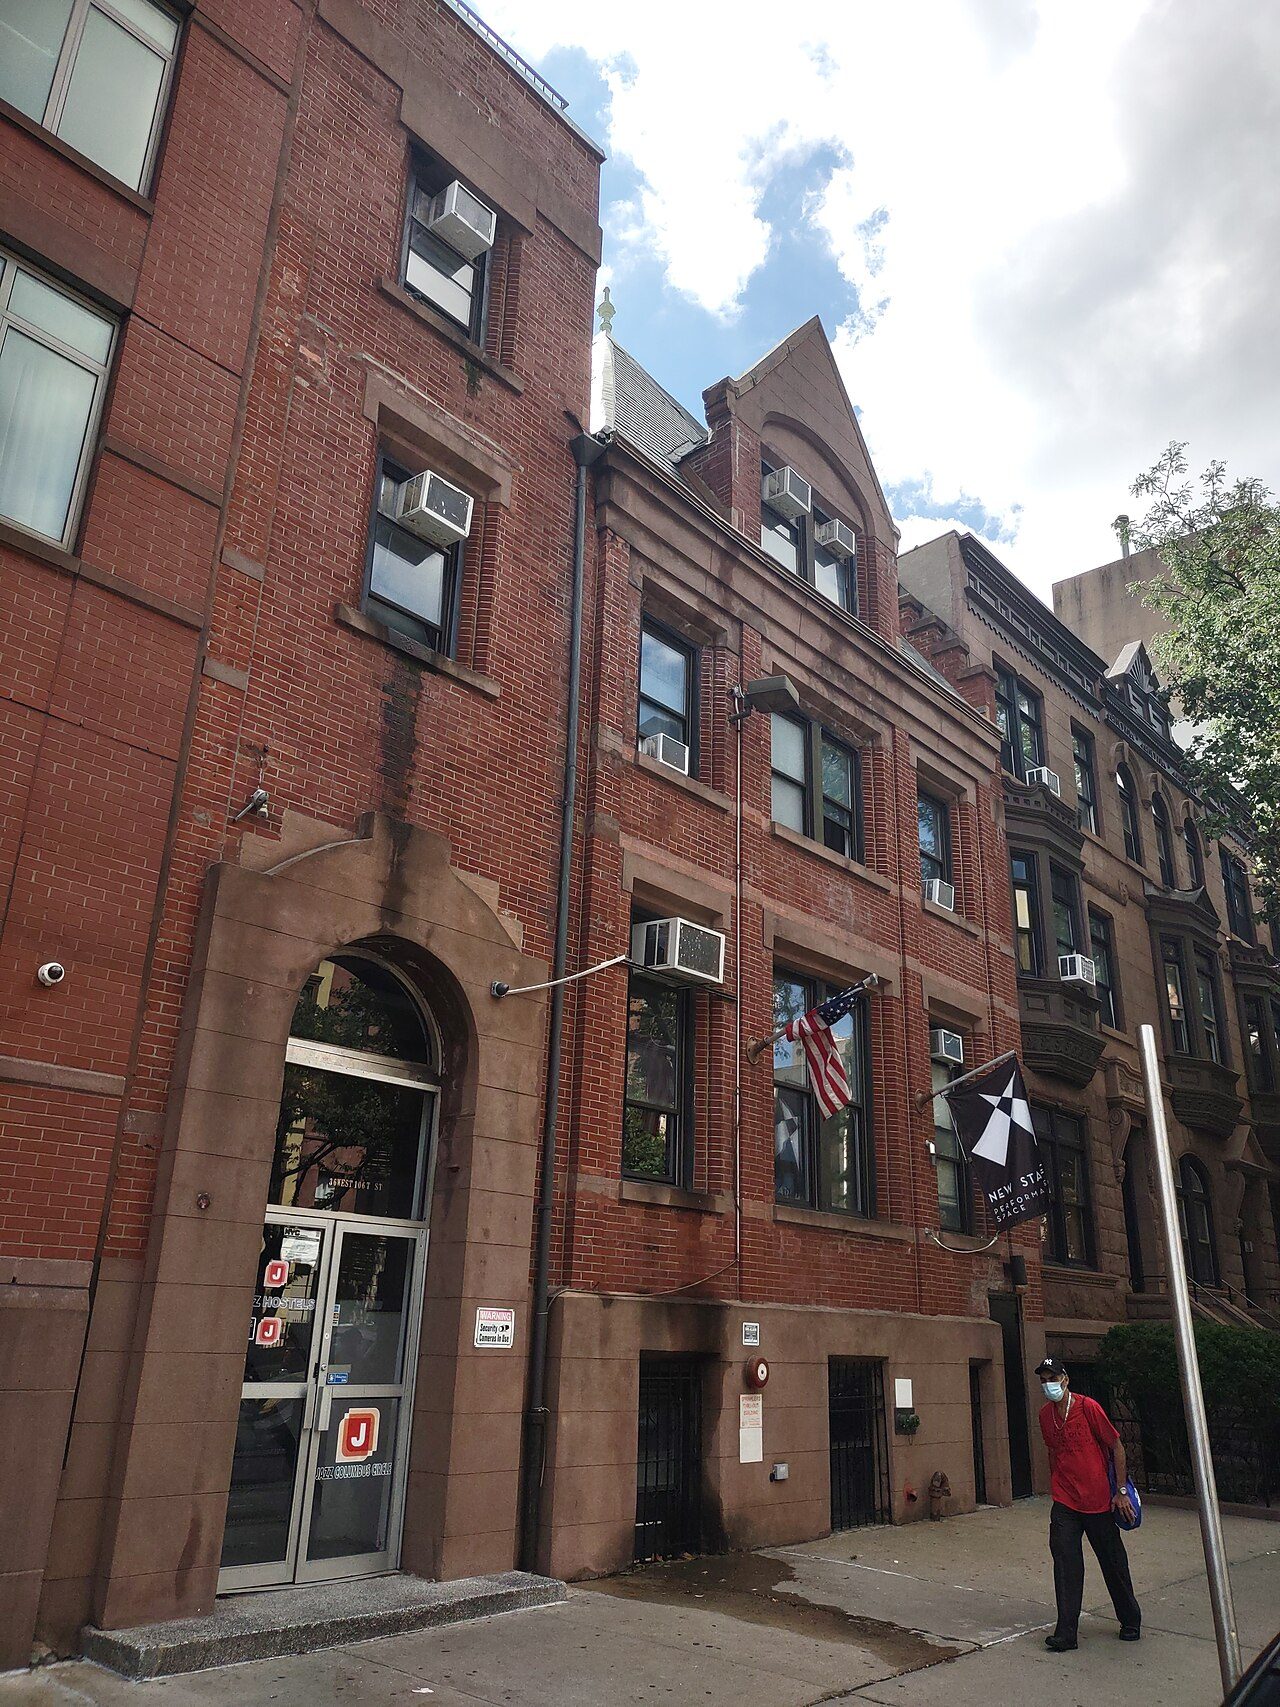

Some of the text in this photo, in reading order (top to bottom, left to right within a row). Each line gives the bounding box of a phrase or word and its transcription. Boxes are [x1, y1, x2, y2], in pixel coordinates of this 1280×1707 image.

[988, 1183, 1012, 1203] NEW
[996, 1204, 1026, 1222] SPACE
[262, 1295, 316, 1310] HOSTELS
[481, 1311, 511, 1320] WARNING
[480, 1323, 498, 1333] Security
[351, 1423, 366, 1447] J
[315, 1462, 392, 1480] JAZZ COLUMBUS CIRCLE
